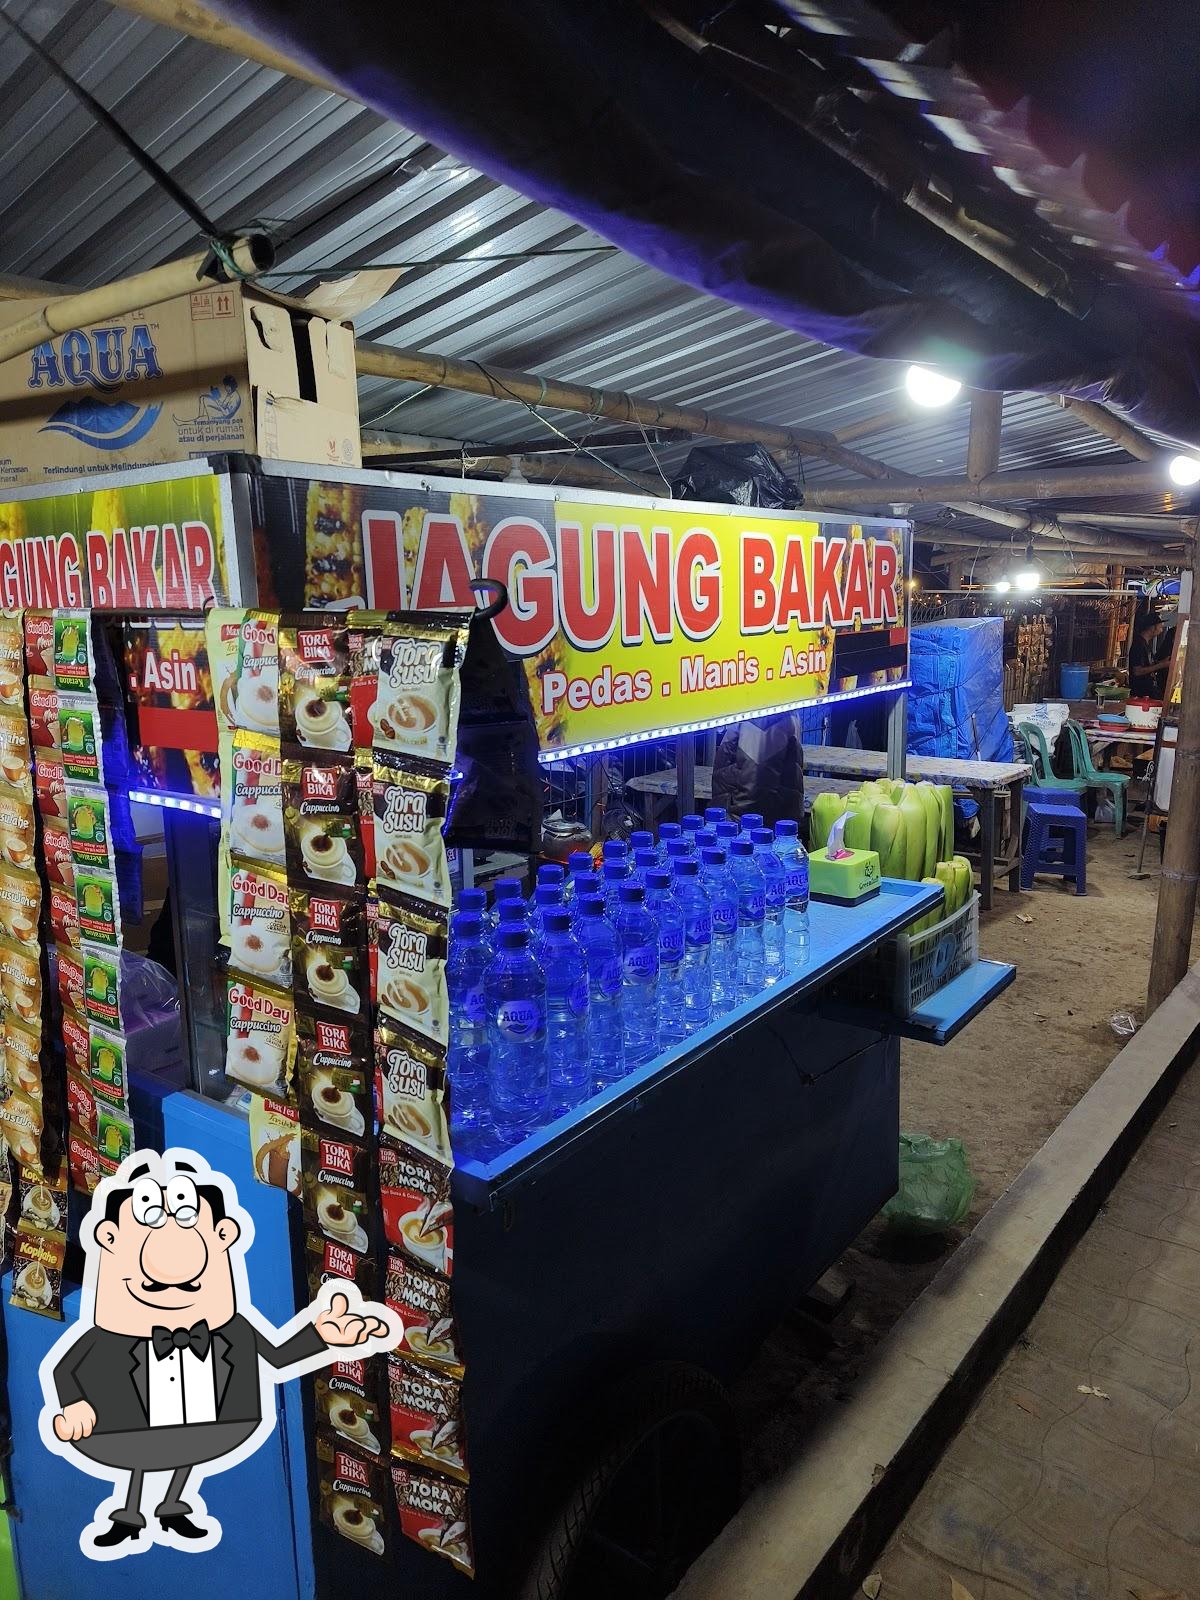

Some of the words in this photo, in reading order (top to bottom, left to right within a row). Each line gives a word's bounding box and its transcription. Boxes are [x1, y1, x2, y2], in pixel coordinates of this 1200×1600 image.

[28, 325, 163, 394] AQUA
[178, 426, 203, 436] untuk
[215, 425, 244, 433] rumah
[205, 433, 244, 442] perjalanan
[43, 465, 85, 475] Terlindungi
[87, 464, 109, 472] untuk
[87, 521, 218, 609] BAKAR
[318, 509, 721, 658] JAGUNG
[739, 532, 901, 636] BAKAR
[242, 623, 276, 645] Good
[300, 634, 330, 646] TORA
[392, 641, 441, 667] Tora
[142, 650, 197, 691] Asin
[541, 664, 652, 714] Pedas
[681, 650, 759, 693] Manis
[780, 643, 827, 678] Asin
[233, 751, 273, 776] Good
[307, 783, 335, 795] BIKA
[300, 801, 340, 815] Cappuccino
[386, 787, 426, 814] Tora
[383, 811, 426, 833] Susu
[231, 872, 266, 898] Good
[232, 903, 284, 919] Cappuccino
[313, 901, 337, 916] TORA
[314, 913, 338, 928] BIKA
[306, 931, 342, 945] Cappuccino
[389, 923, 427, 954] Tora
[386, 947, 425, 973] Susu
[228, 987, 262, 1012] Good
[264, 1000, 290, 1026] Day
[502, 1008, 533, 1022] AQUA
[230, 1016, 281, 1033] Cappuccino
[319, 1025, 346, 1041] TORA
[322, 1036, 348, 1050] BIKA
[313, 1052, 352, 1068] Cappuccino
[388, 1050, 427, 1083] Tora
[388, 1074, 426, 1101] Susu
[322, 1143, 350, 1160] TORA
[325, 1153, 351, 1171] BIKA
[399, 1160, 431, 1182] TORA
[317, 1170, 355, 1189] Cappuccino
[399, 1174, 438, 1195] MOKA
[328, 1245, 354, 1265] TORA
[389, 1257, 404, 1268] TORA
[329, 1257, 354, 1276] BIKA
[390, 1264, 404, 1273] BIKA
[405, 1272, 437, 1298] TORA
[402, 1287, 441, 1313] MOKA
[329, 1377, 365, 1397] Cappuccino
[402, 1380, 444, 1401] TORA
[402, 1394, 448, 1416] MOKA
[338, 1453, 366, 1475] TORA
[340, 1465, 367, 1482] BIKA
[333, 1479, 372, 1498] Cappuccino
[410, 1480, 451, 1503] TORA
[409, 1494, 456, 1517] MOKA
